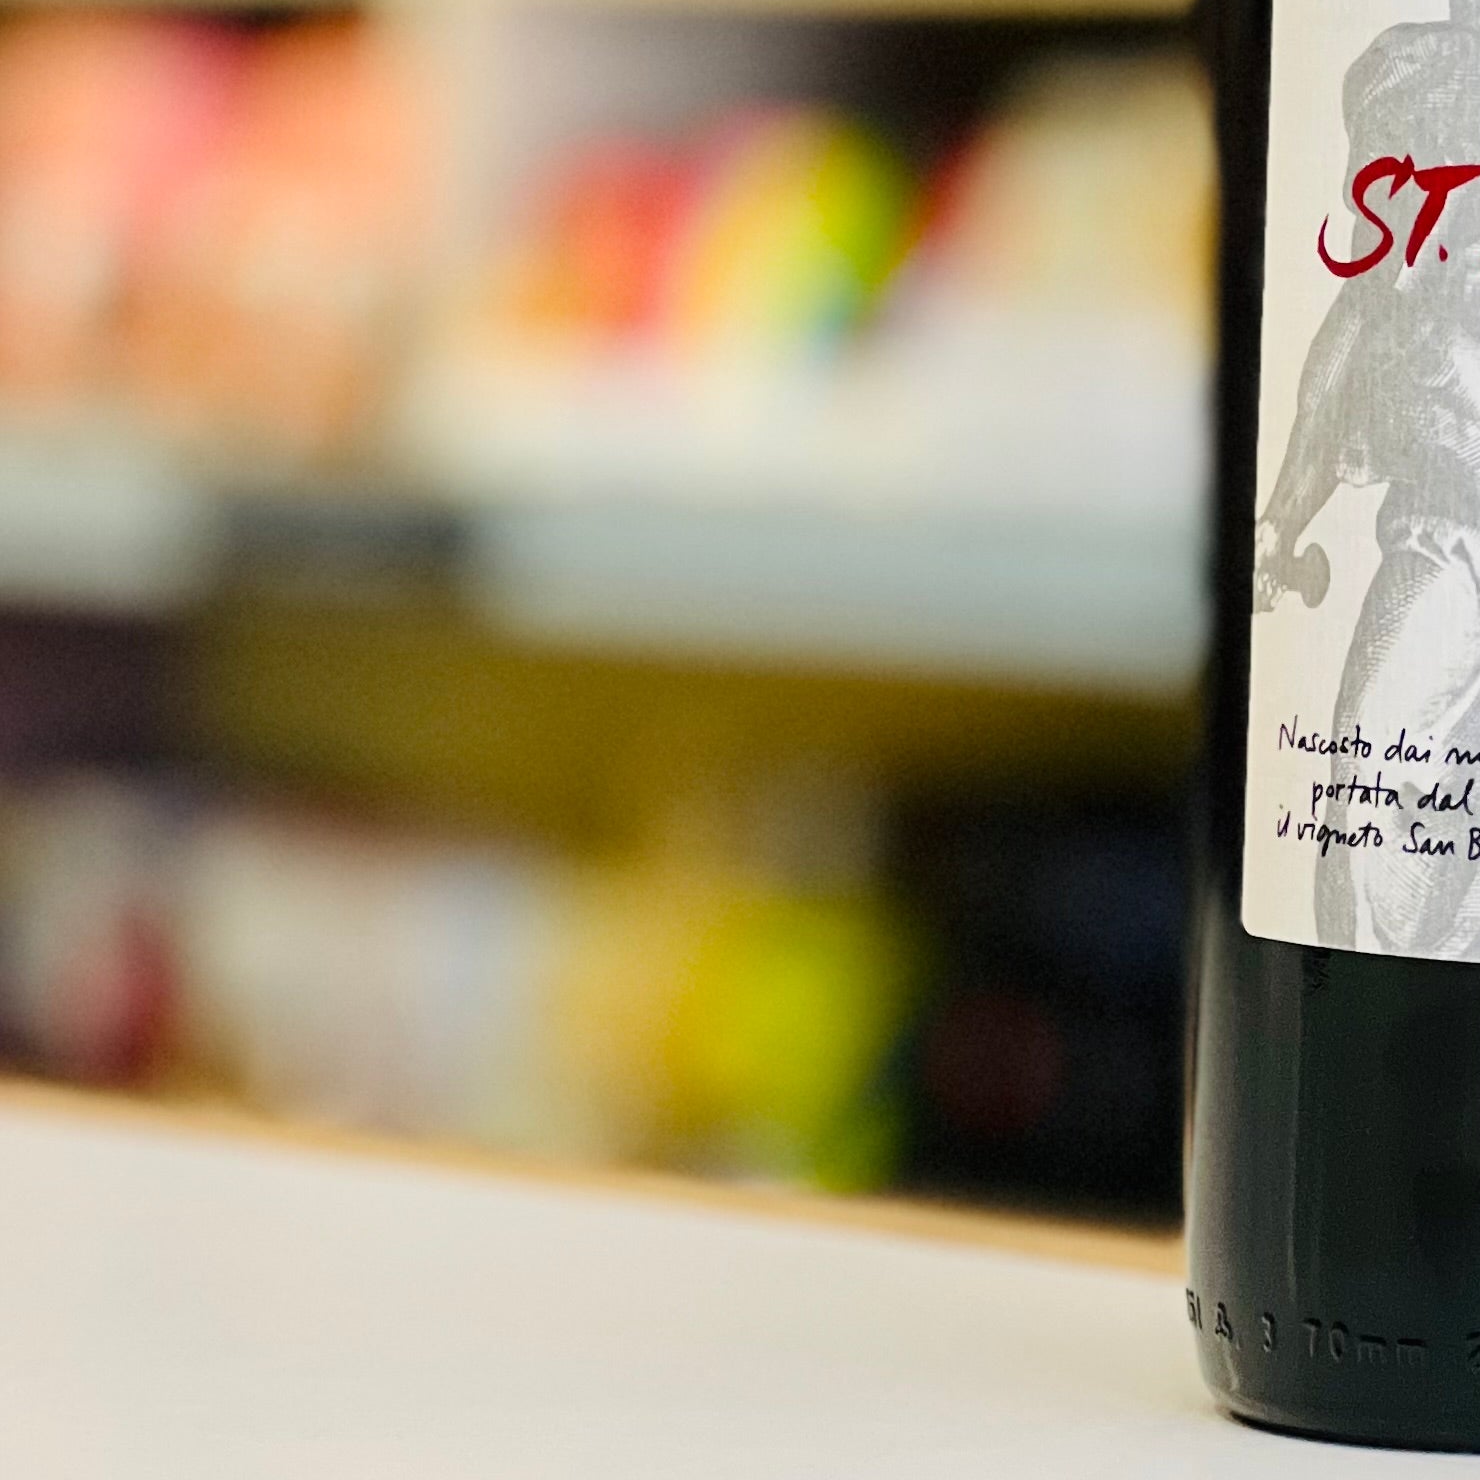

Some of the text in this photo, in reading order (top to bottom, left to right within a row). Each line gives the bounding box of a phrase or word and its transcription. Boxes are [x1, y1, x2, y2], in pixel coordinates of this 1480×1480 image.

[1278, 714, 1373, 759] Nascosto
[1383, 727, 1432, 764] dai
[1311, 770, 1405, 810] portata
[1416, 777, 1475, 817] dal
[1276, 803, 1293, 838] il
[1297, 821, 1384, 859] vigneto
[1401, 821, 1456, 856] San
